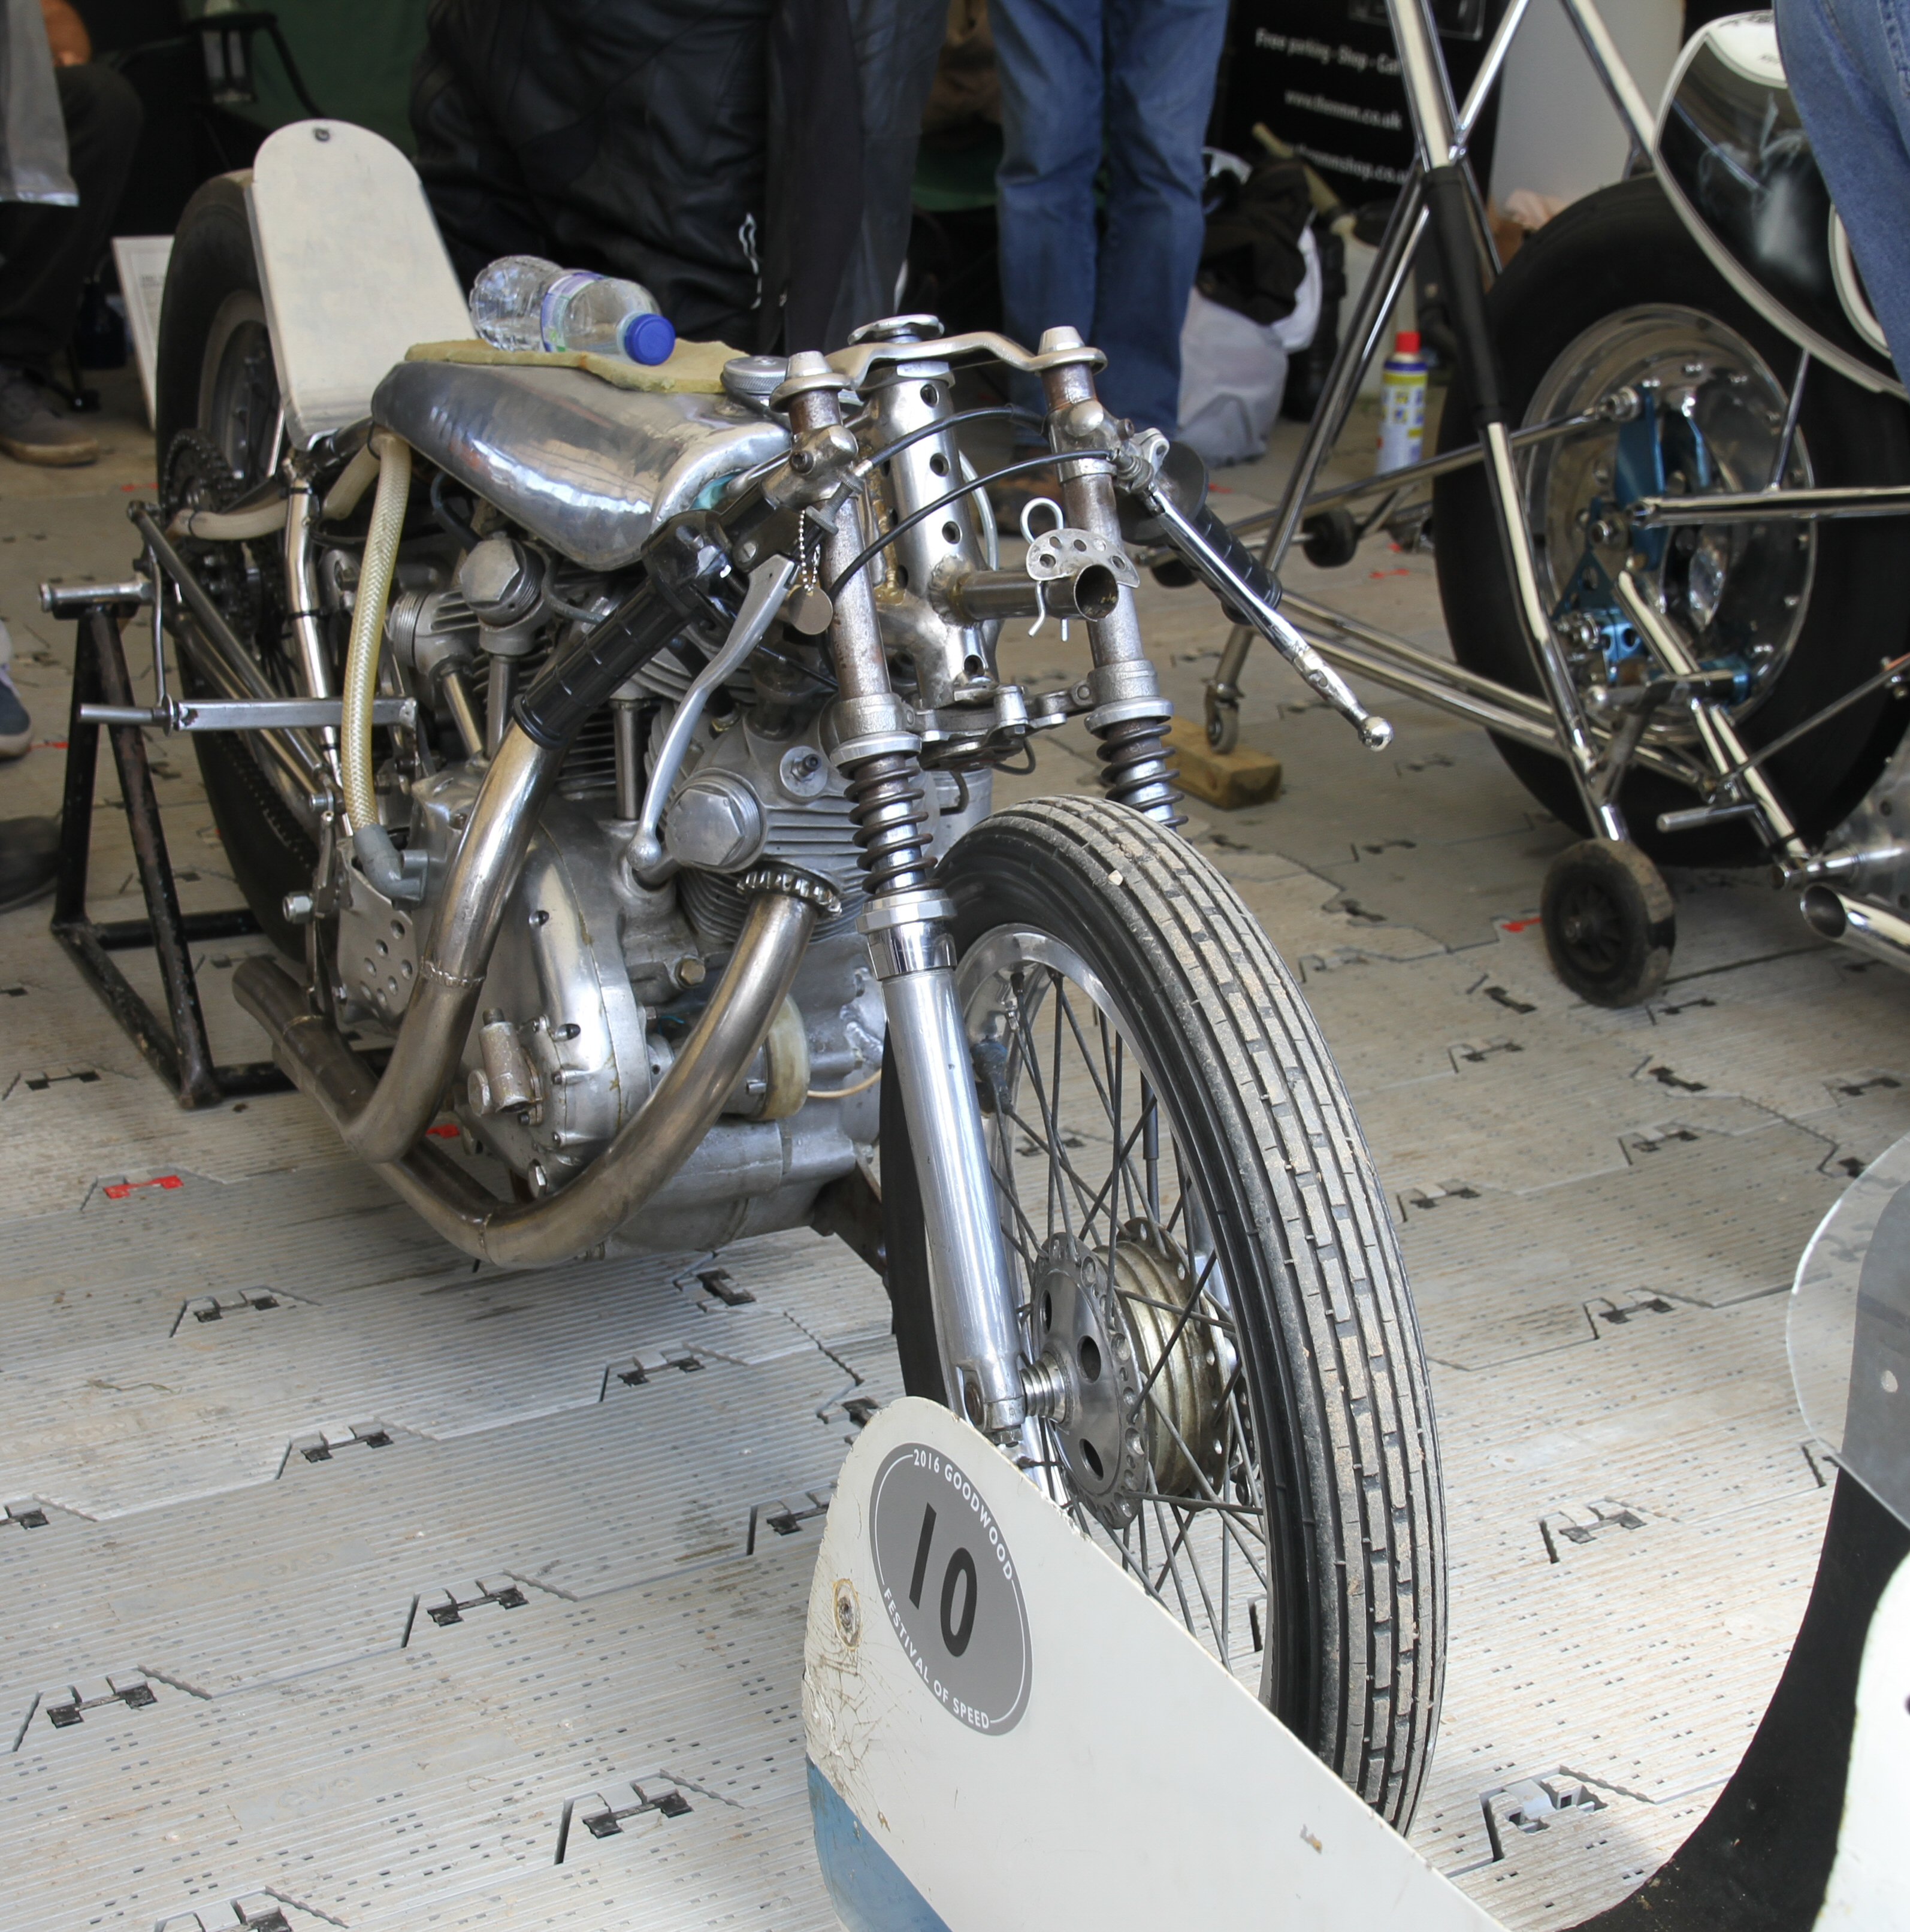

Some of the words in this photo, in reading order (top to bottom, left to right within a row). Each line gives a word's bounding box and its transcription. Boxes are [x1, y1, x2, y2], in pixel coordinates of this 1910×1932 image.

[1255, 28, 1286, 52] Free
[1288, 37, 1331, 65] parking
[1338, 44, 1368, 72] Shop
[908, 1502, 978, 1658] 10
[913, 1448, 940, 1474] 2016
[944, 1464, 1013, 1580] GOODWOOD
[883, 1588, 930, 1684] FESTIVAL
[933, 1680, 949, 1703] OF
[953, 1697, 990, 1730] SPEED
